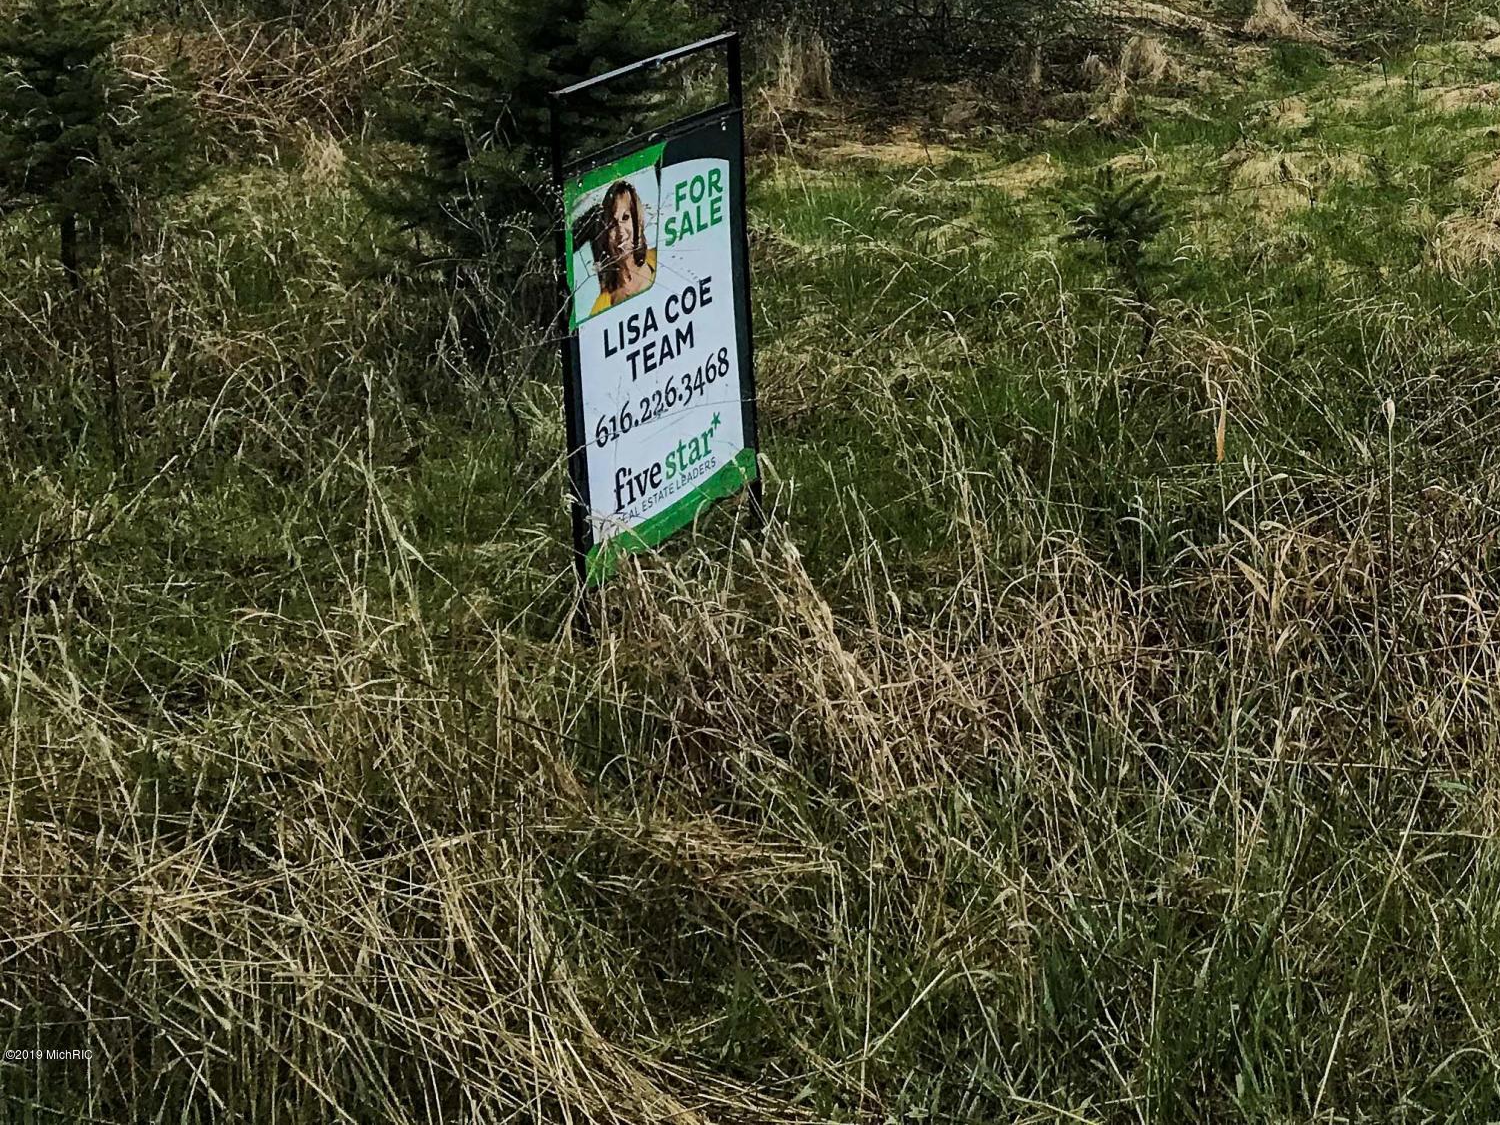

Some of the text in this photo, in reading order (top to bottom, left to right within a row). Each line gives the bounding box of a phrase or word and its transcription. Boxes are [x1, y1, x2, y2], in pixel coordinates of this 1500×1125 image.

[664, 196, 723, 247] SALE
[674, 168, 723, 212] FOR
[603, 276, 713, 359] LISA COE
[626, 321, 695, 382] TEAM
[595, 347, 730, 449] 616.226.3468
[616, 457, 717, 524] EAL ESTATE LEADERS
